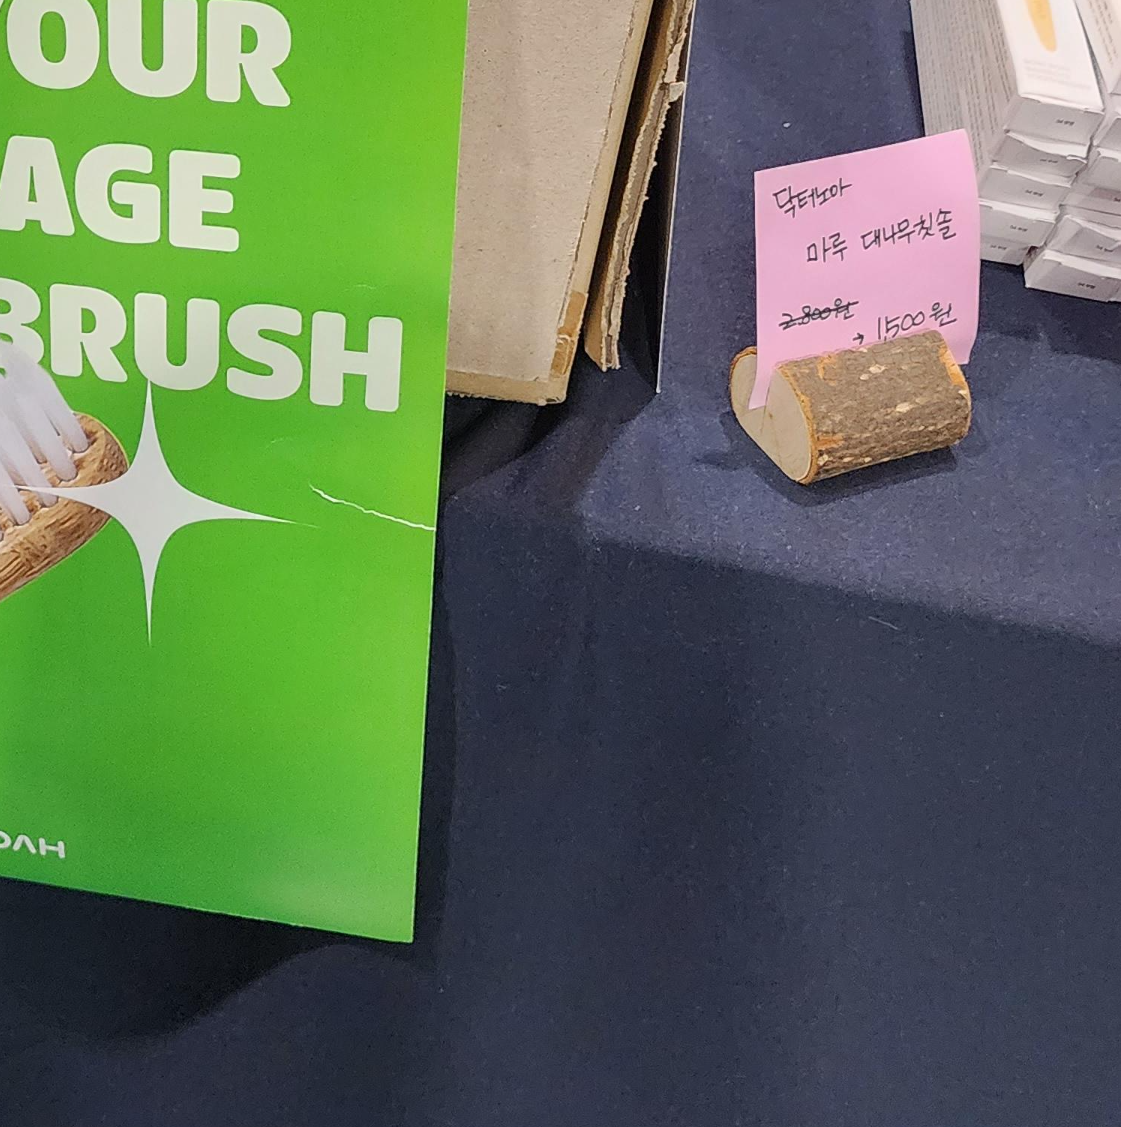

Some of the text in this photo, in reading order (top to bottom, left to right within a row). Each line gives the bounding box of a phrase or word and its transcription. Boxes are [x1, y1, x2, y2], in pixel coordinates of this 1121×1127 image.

[772, 177, 853, 219] 닥터노아
[806, 208, 957, 263] 마루 대나무칫솔
